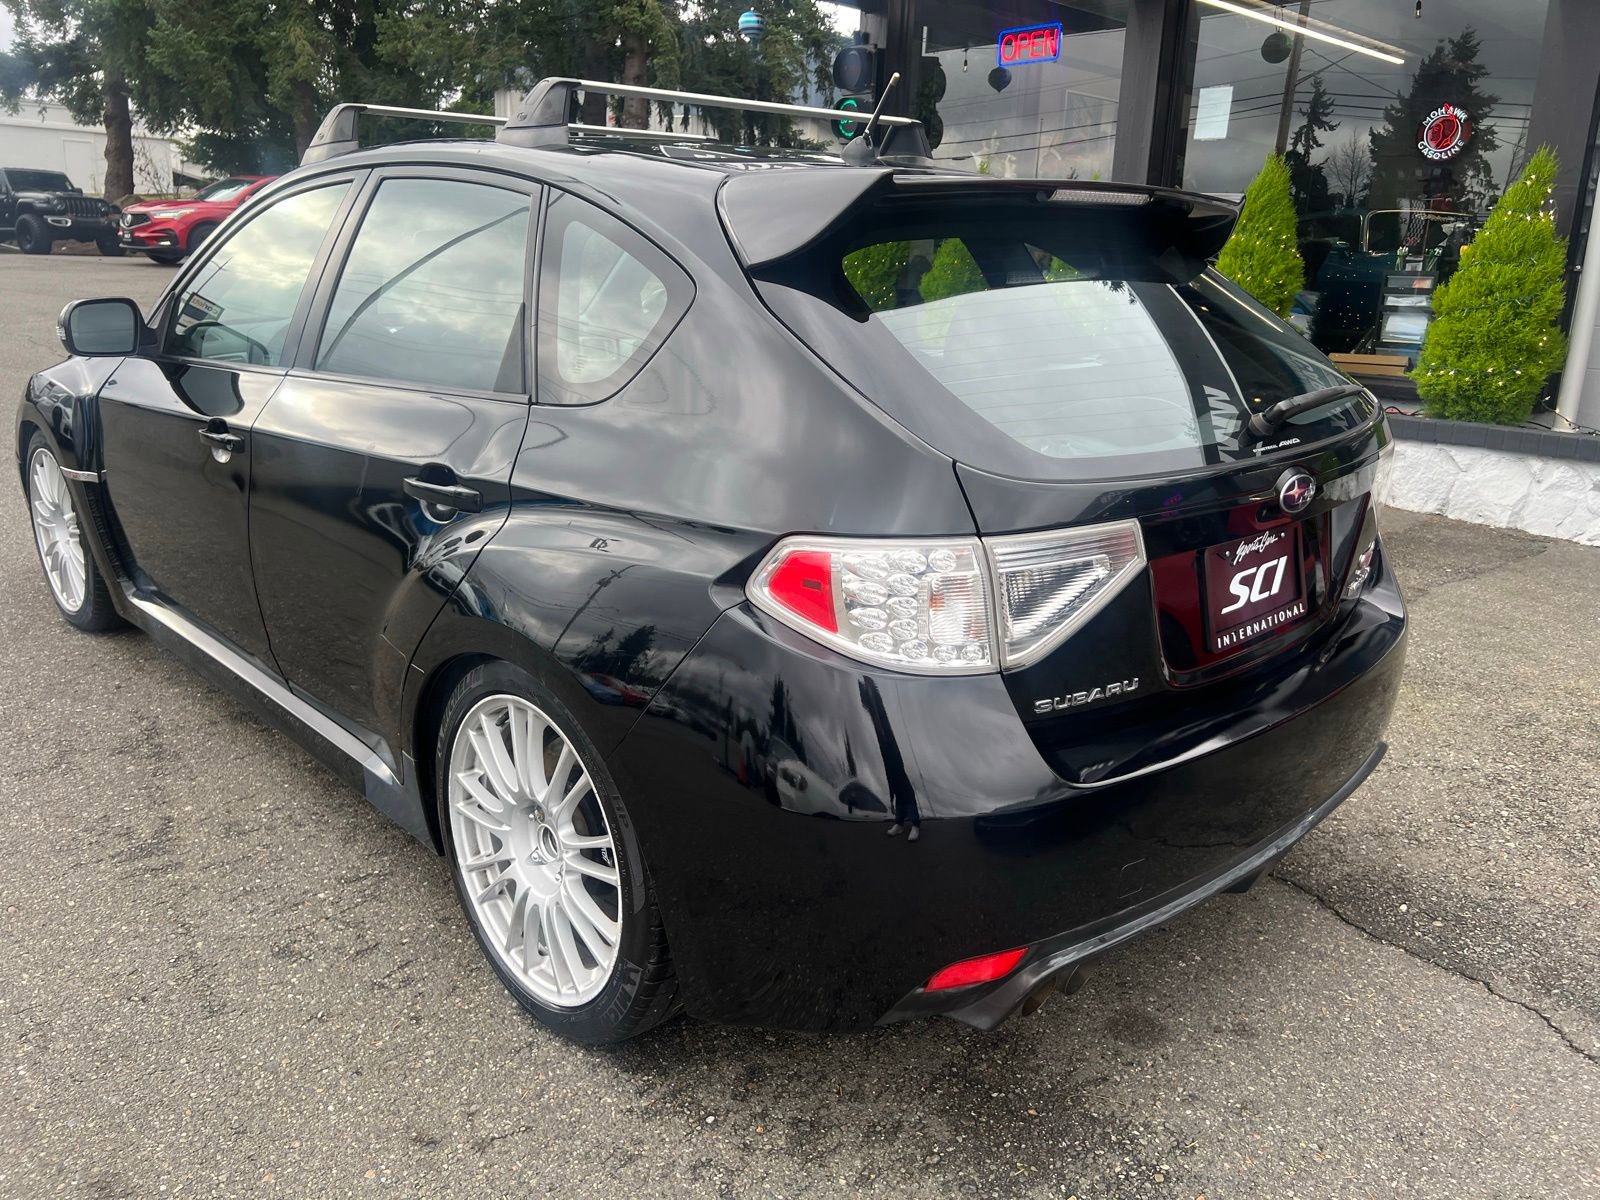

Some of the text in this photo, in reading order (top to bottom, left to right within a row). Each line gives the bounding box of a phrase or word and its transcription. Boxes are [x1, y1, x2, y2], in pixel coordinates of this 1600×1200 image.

[1001, 29, 1058, 62] OPEN
[1422, 106, 1468, 127] MOHAWK
[1417, 139, 1464, 160] GASOLINE
[1221, 556, 1288, 615] SCI
[1217, 603, 1305, 649] INTERNATIONAL
[1034, 677, 1139, 714] SUBARU
